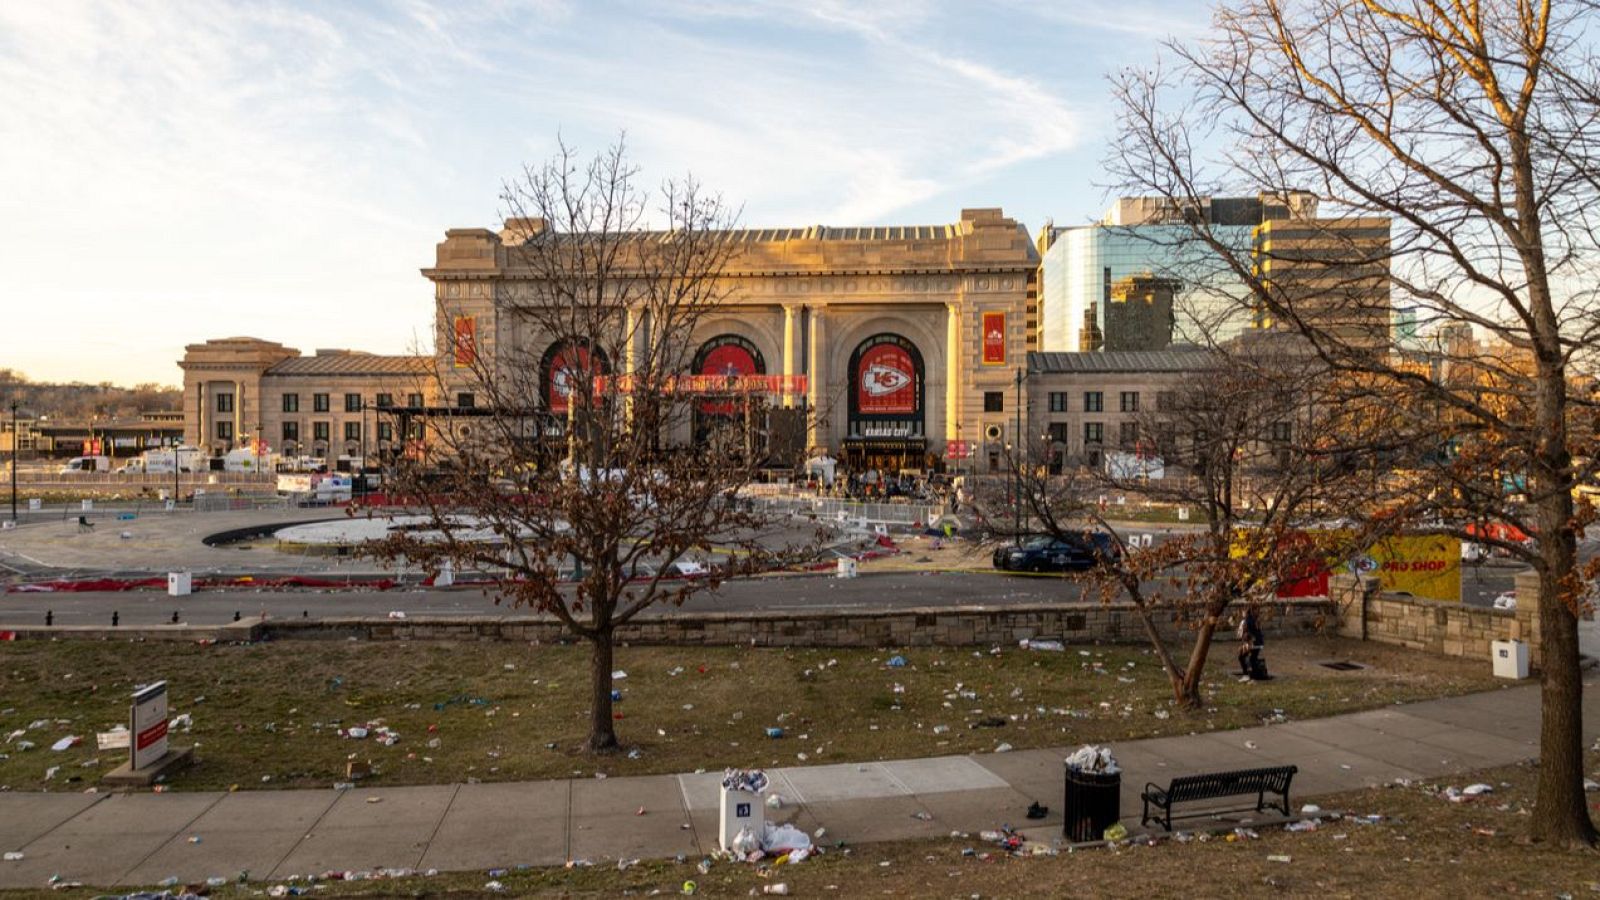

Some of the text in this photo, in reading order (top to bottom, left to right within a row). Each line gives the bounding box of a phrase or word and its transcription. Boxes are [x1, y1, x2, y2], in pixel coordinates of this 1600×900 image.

[866, 428, 909, 437] KANSAS CITY
[1383, 561, 1408, 572] PRO
[1411, 561, 1446, 571] SHOP
